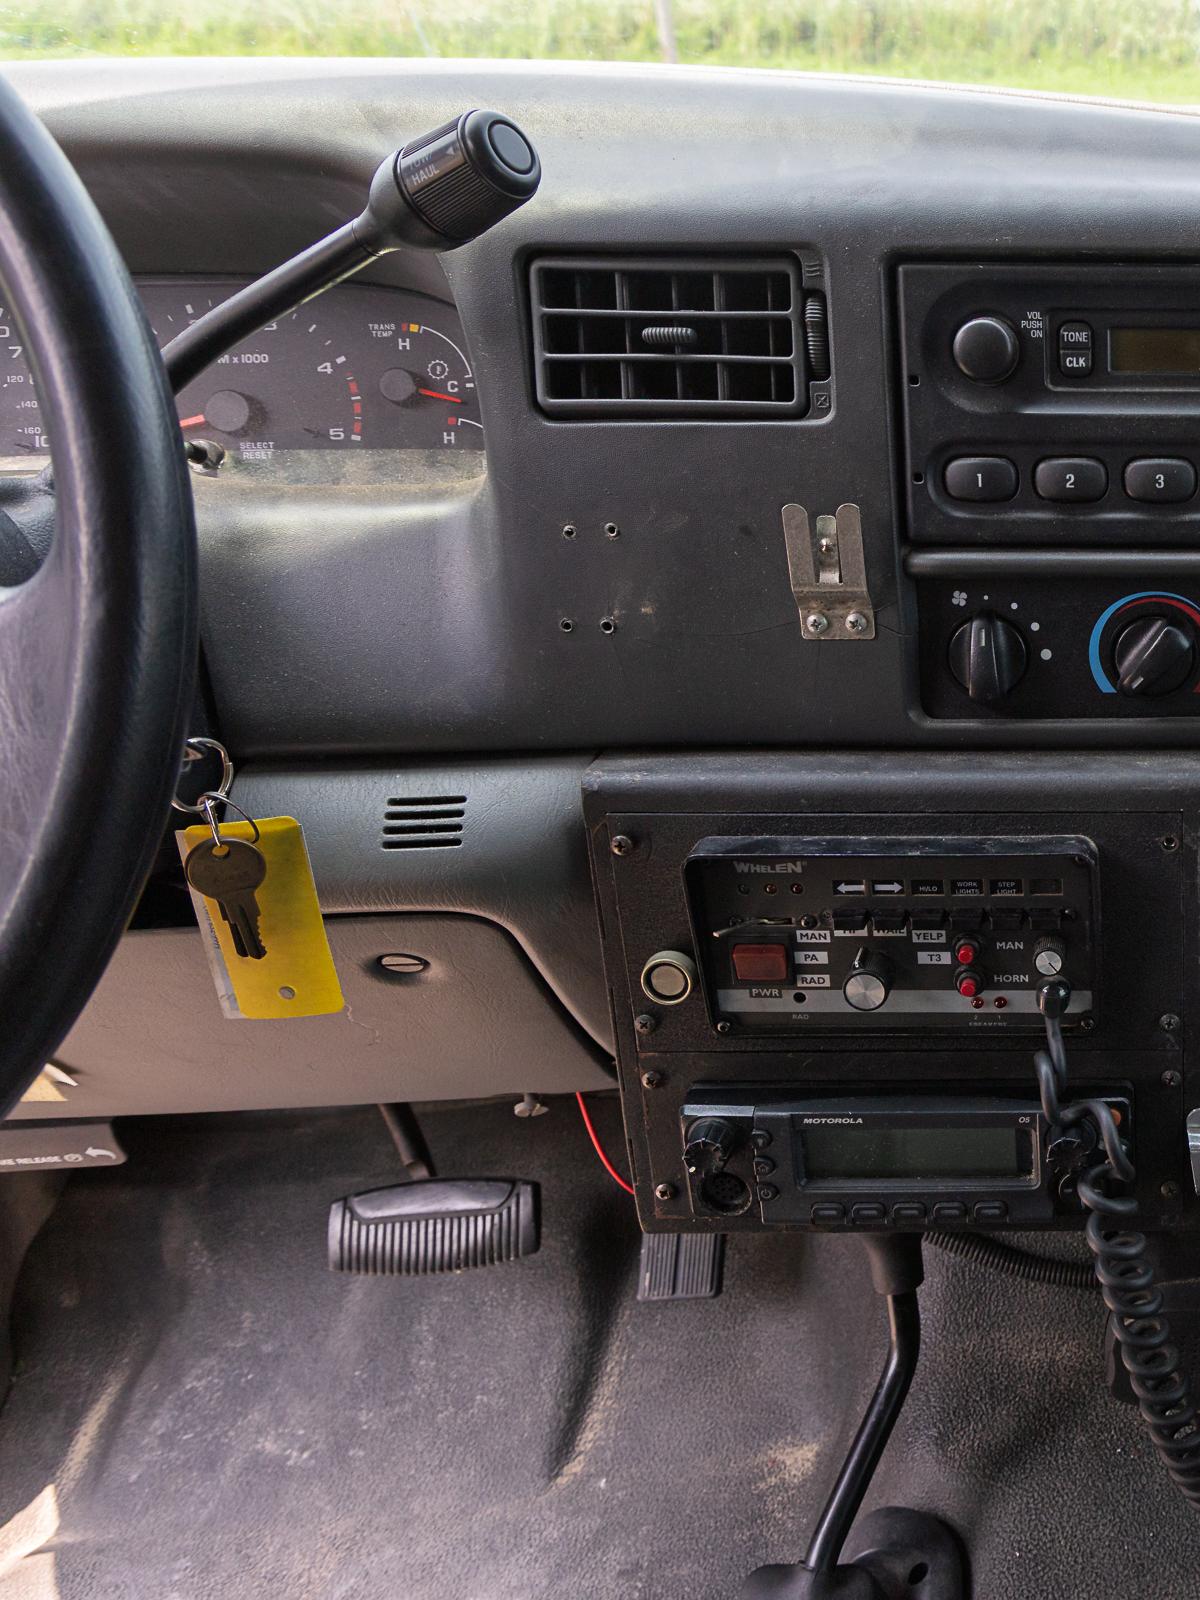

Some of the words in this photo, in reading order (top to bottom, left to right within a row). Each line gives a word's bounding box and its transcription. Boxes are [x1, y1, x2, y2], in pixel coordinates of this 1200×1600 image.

[411, 164, 440, 186] HAUL
[1026, 311, 1042, 320] VOL
[1021, 320, 1043, 329] PUSH
[1030, 330, 1043, 338] ON
[1063, 331, 1088, 342] TONE
[399, 338, 410, 350] H
[242, 354, 269, 363] 1000
[1066, 357, 1086, 368] CLK
[317, 362, 333, 374] 4
[448, 381, 458, 392] C
[329, 428, 345, 440] 5
[443, 432, 455, 444] H
[242, 451, 272, 459] RESET
[976, 473, 983, 488] 1
[1065, 474, 1075, 488] 2
[1155, 474, 1165, 489] 3
[733, 860, 803, 873] WHELEN
[800, 932, 828, 941] MAN
[914, 932, 943, 941] YELP
[996, 941, 1024, 950] MAN
[804, 953, 819, 962] PA
[927, 953, 942, 962] T3
[801, 976, 826, 985] RAD
[993, 974, 1029, 983] HORN
[751, 988, 780, 997] PWR
